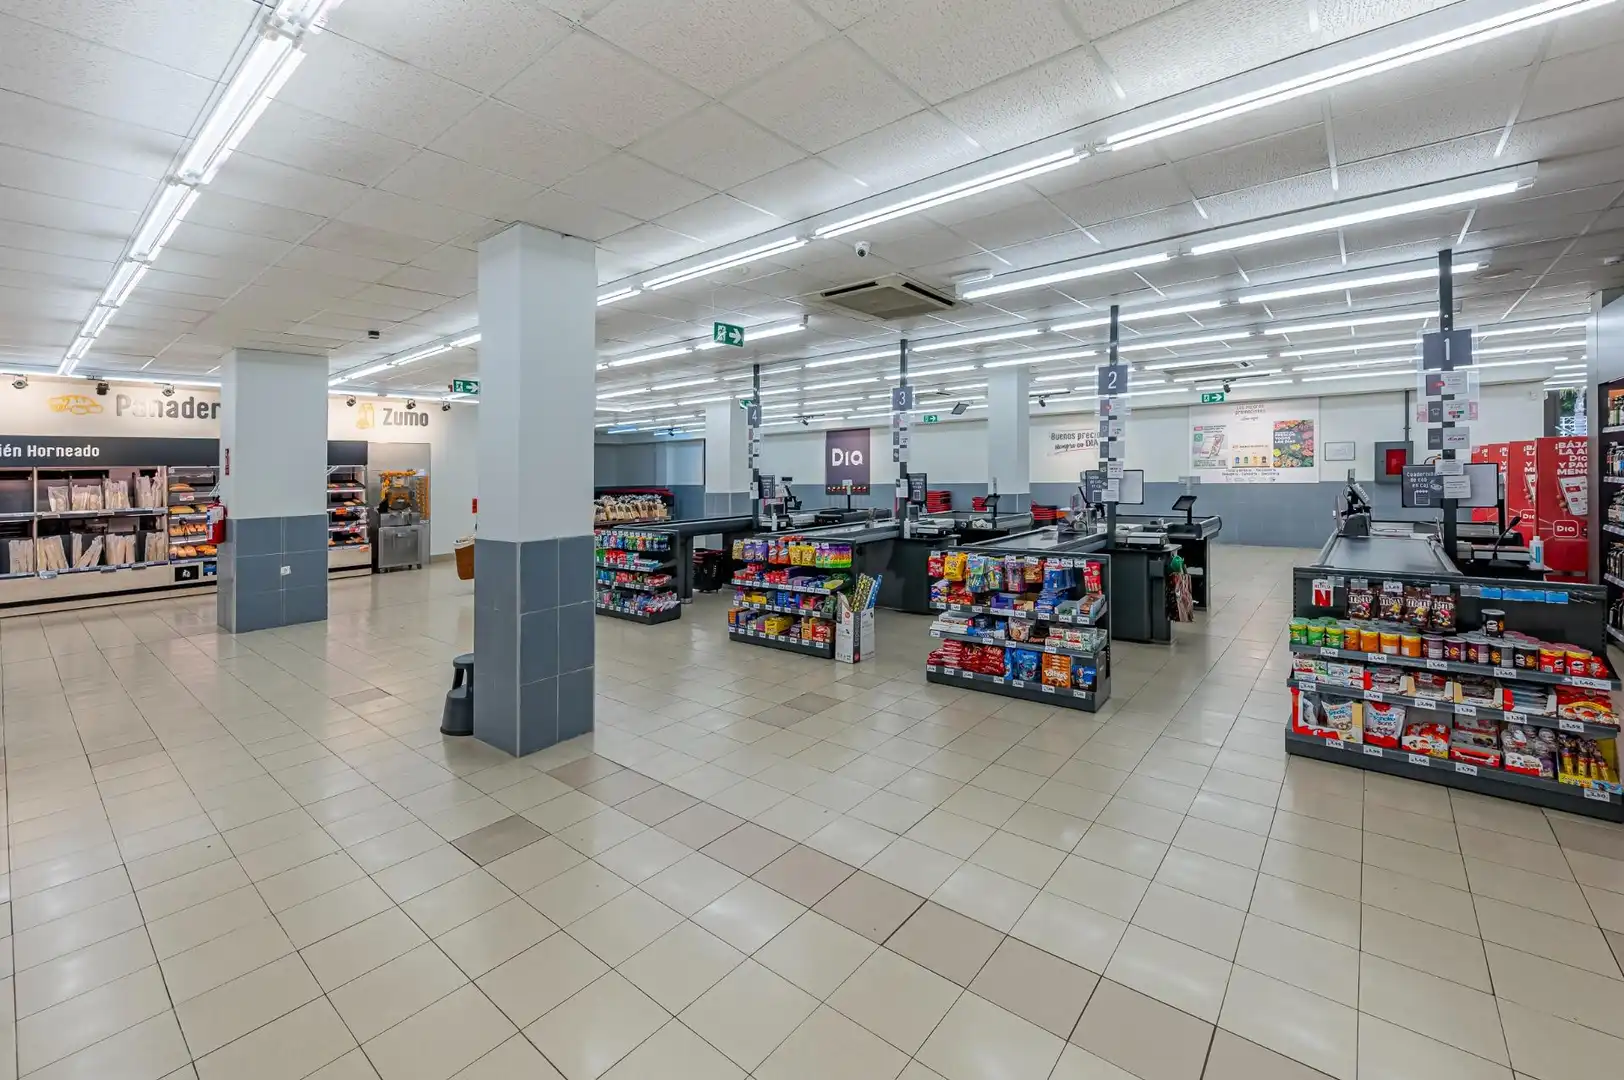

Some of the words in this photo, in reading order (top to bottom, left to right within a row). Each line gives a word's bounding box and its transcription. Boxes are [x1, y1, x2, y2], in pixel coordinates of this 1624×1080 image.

[1444, 338, 1450, 360] 1
[1108, 372, 1118, 389] 2
[116, 394, 221, 420] Panader
[899, 391, 906, 406] 3
[382, 408, 428, 426] Zumo
[752, 410, 758, 422] 4
[1050, 432, 1076, 440] Buenos
[27, 444, 100, 458] Horneado
[1314, 589, 1331, 606] N
